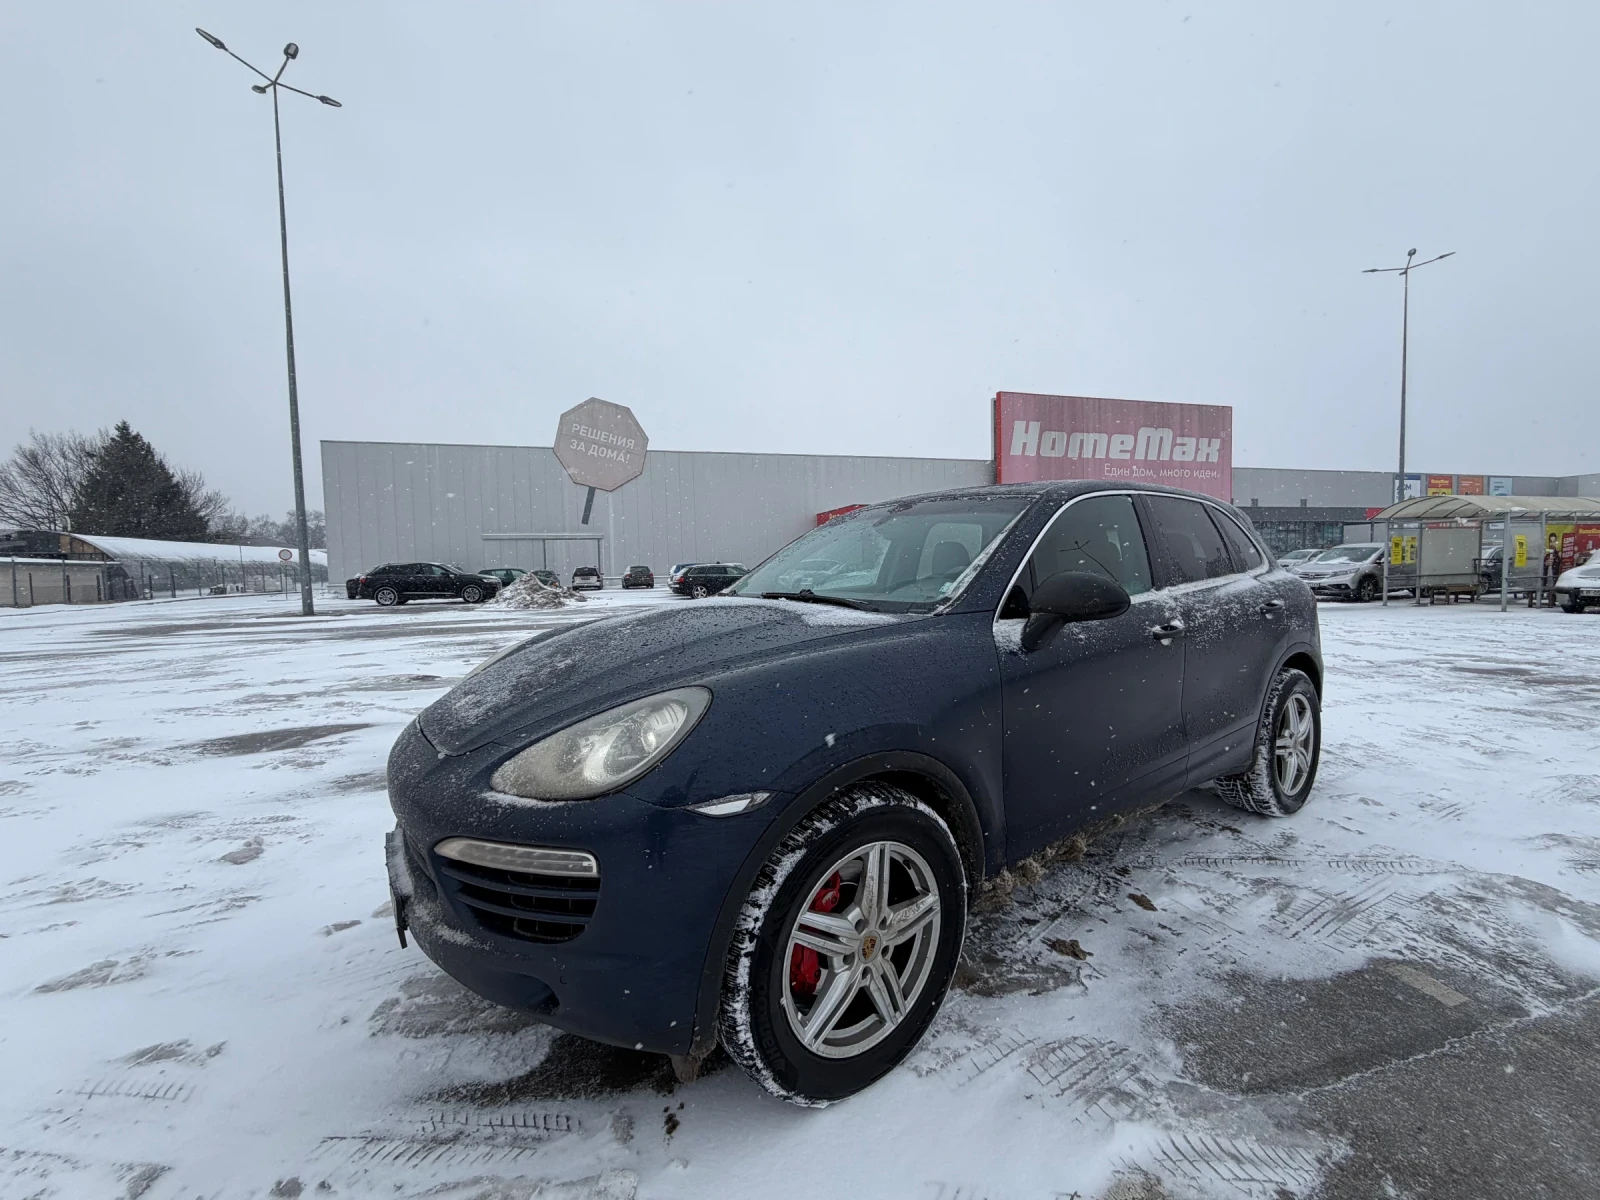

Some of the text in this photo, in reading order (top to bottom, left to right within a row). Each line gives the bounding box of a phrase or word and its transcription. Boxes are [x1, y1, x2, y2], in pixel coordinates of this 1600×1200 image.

[570, 439, 631, 464] ЗА ДОМА!
[1009, 420, 1221, 463] HomeMax
[1104, 463, 1130, 477] Един
[1160, 468, 1191, 478] много
